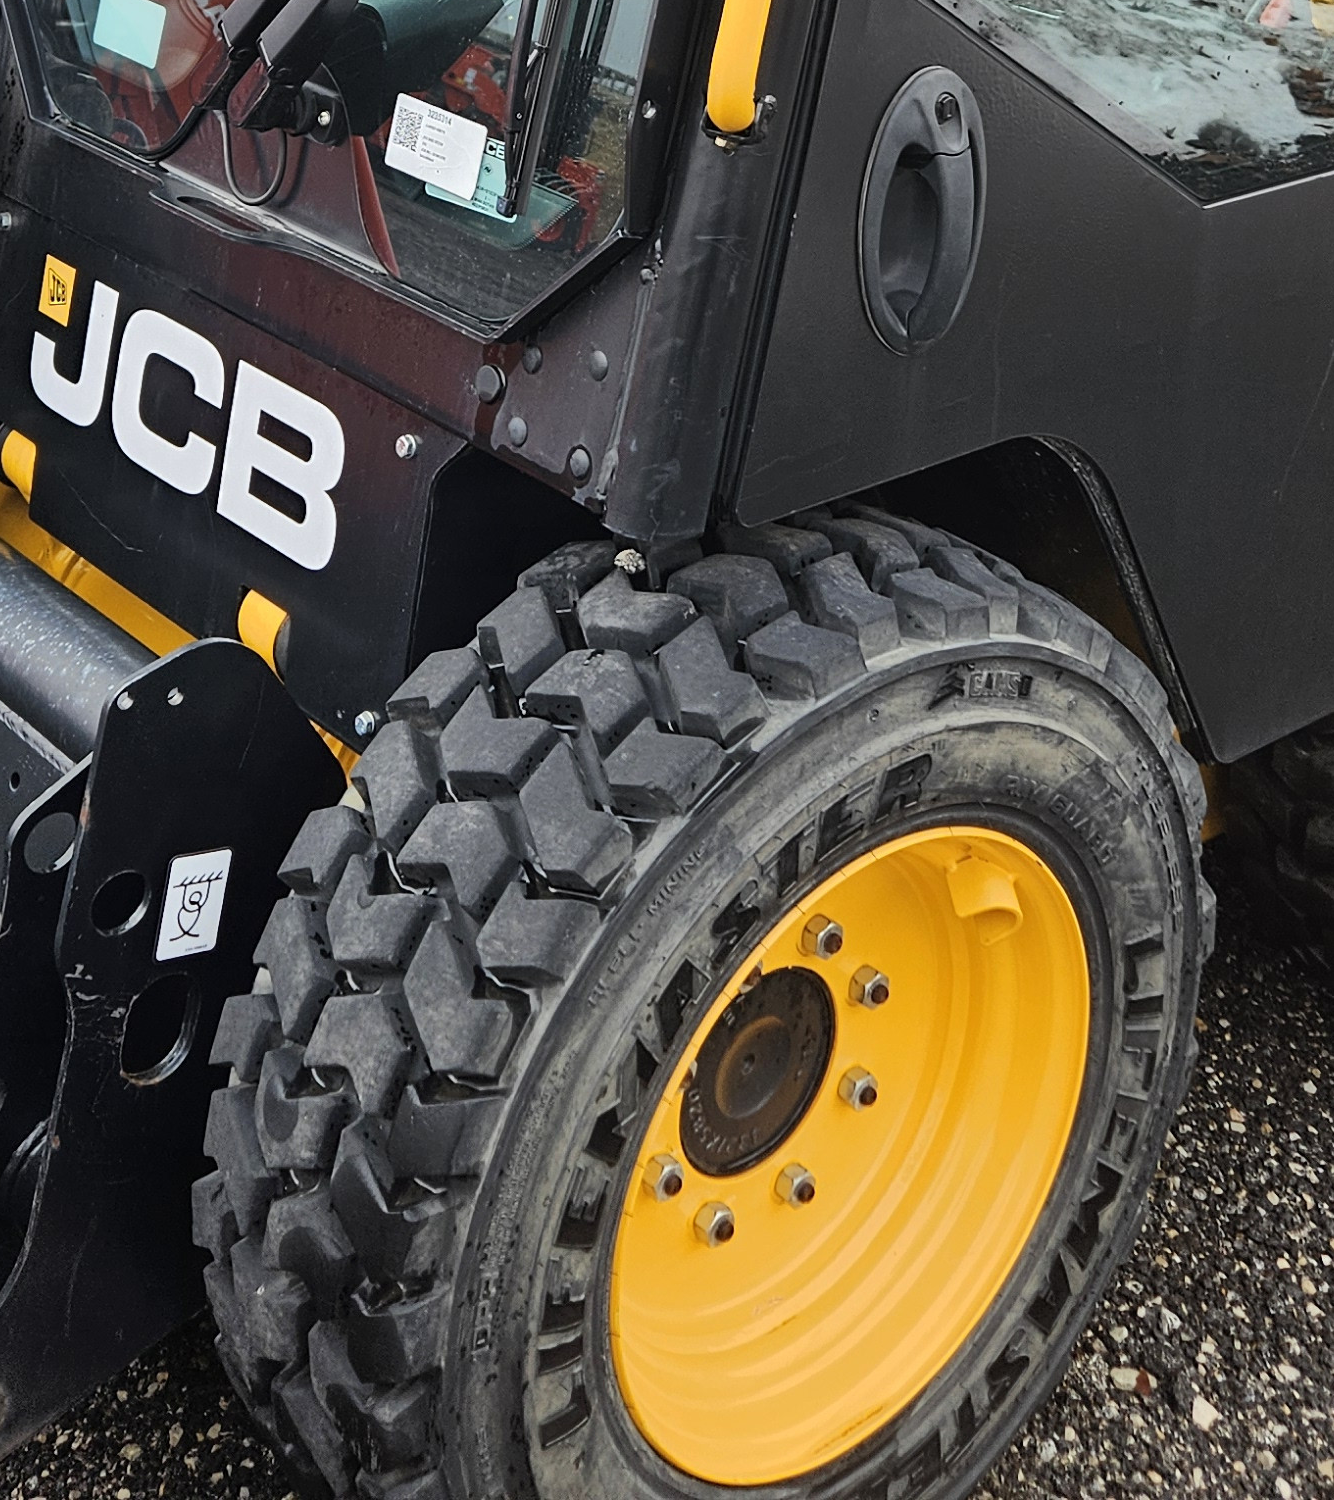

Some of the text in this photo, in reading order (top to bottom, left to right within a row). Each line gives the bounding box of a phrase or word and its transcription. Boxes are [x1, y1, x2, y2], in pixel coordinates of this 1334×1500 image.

[30, 280, 345, 571] JCB
[49, 272, 67, 304] JCB
[537, 752, 933, 1452] LIFEMASTER
